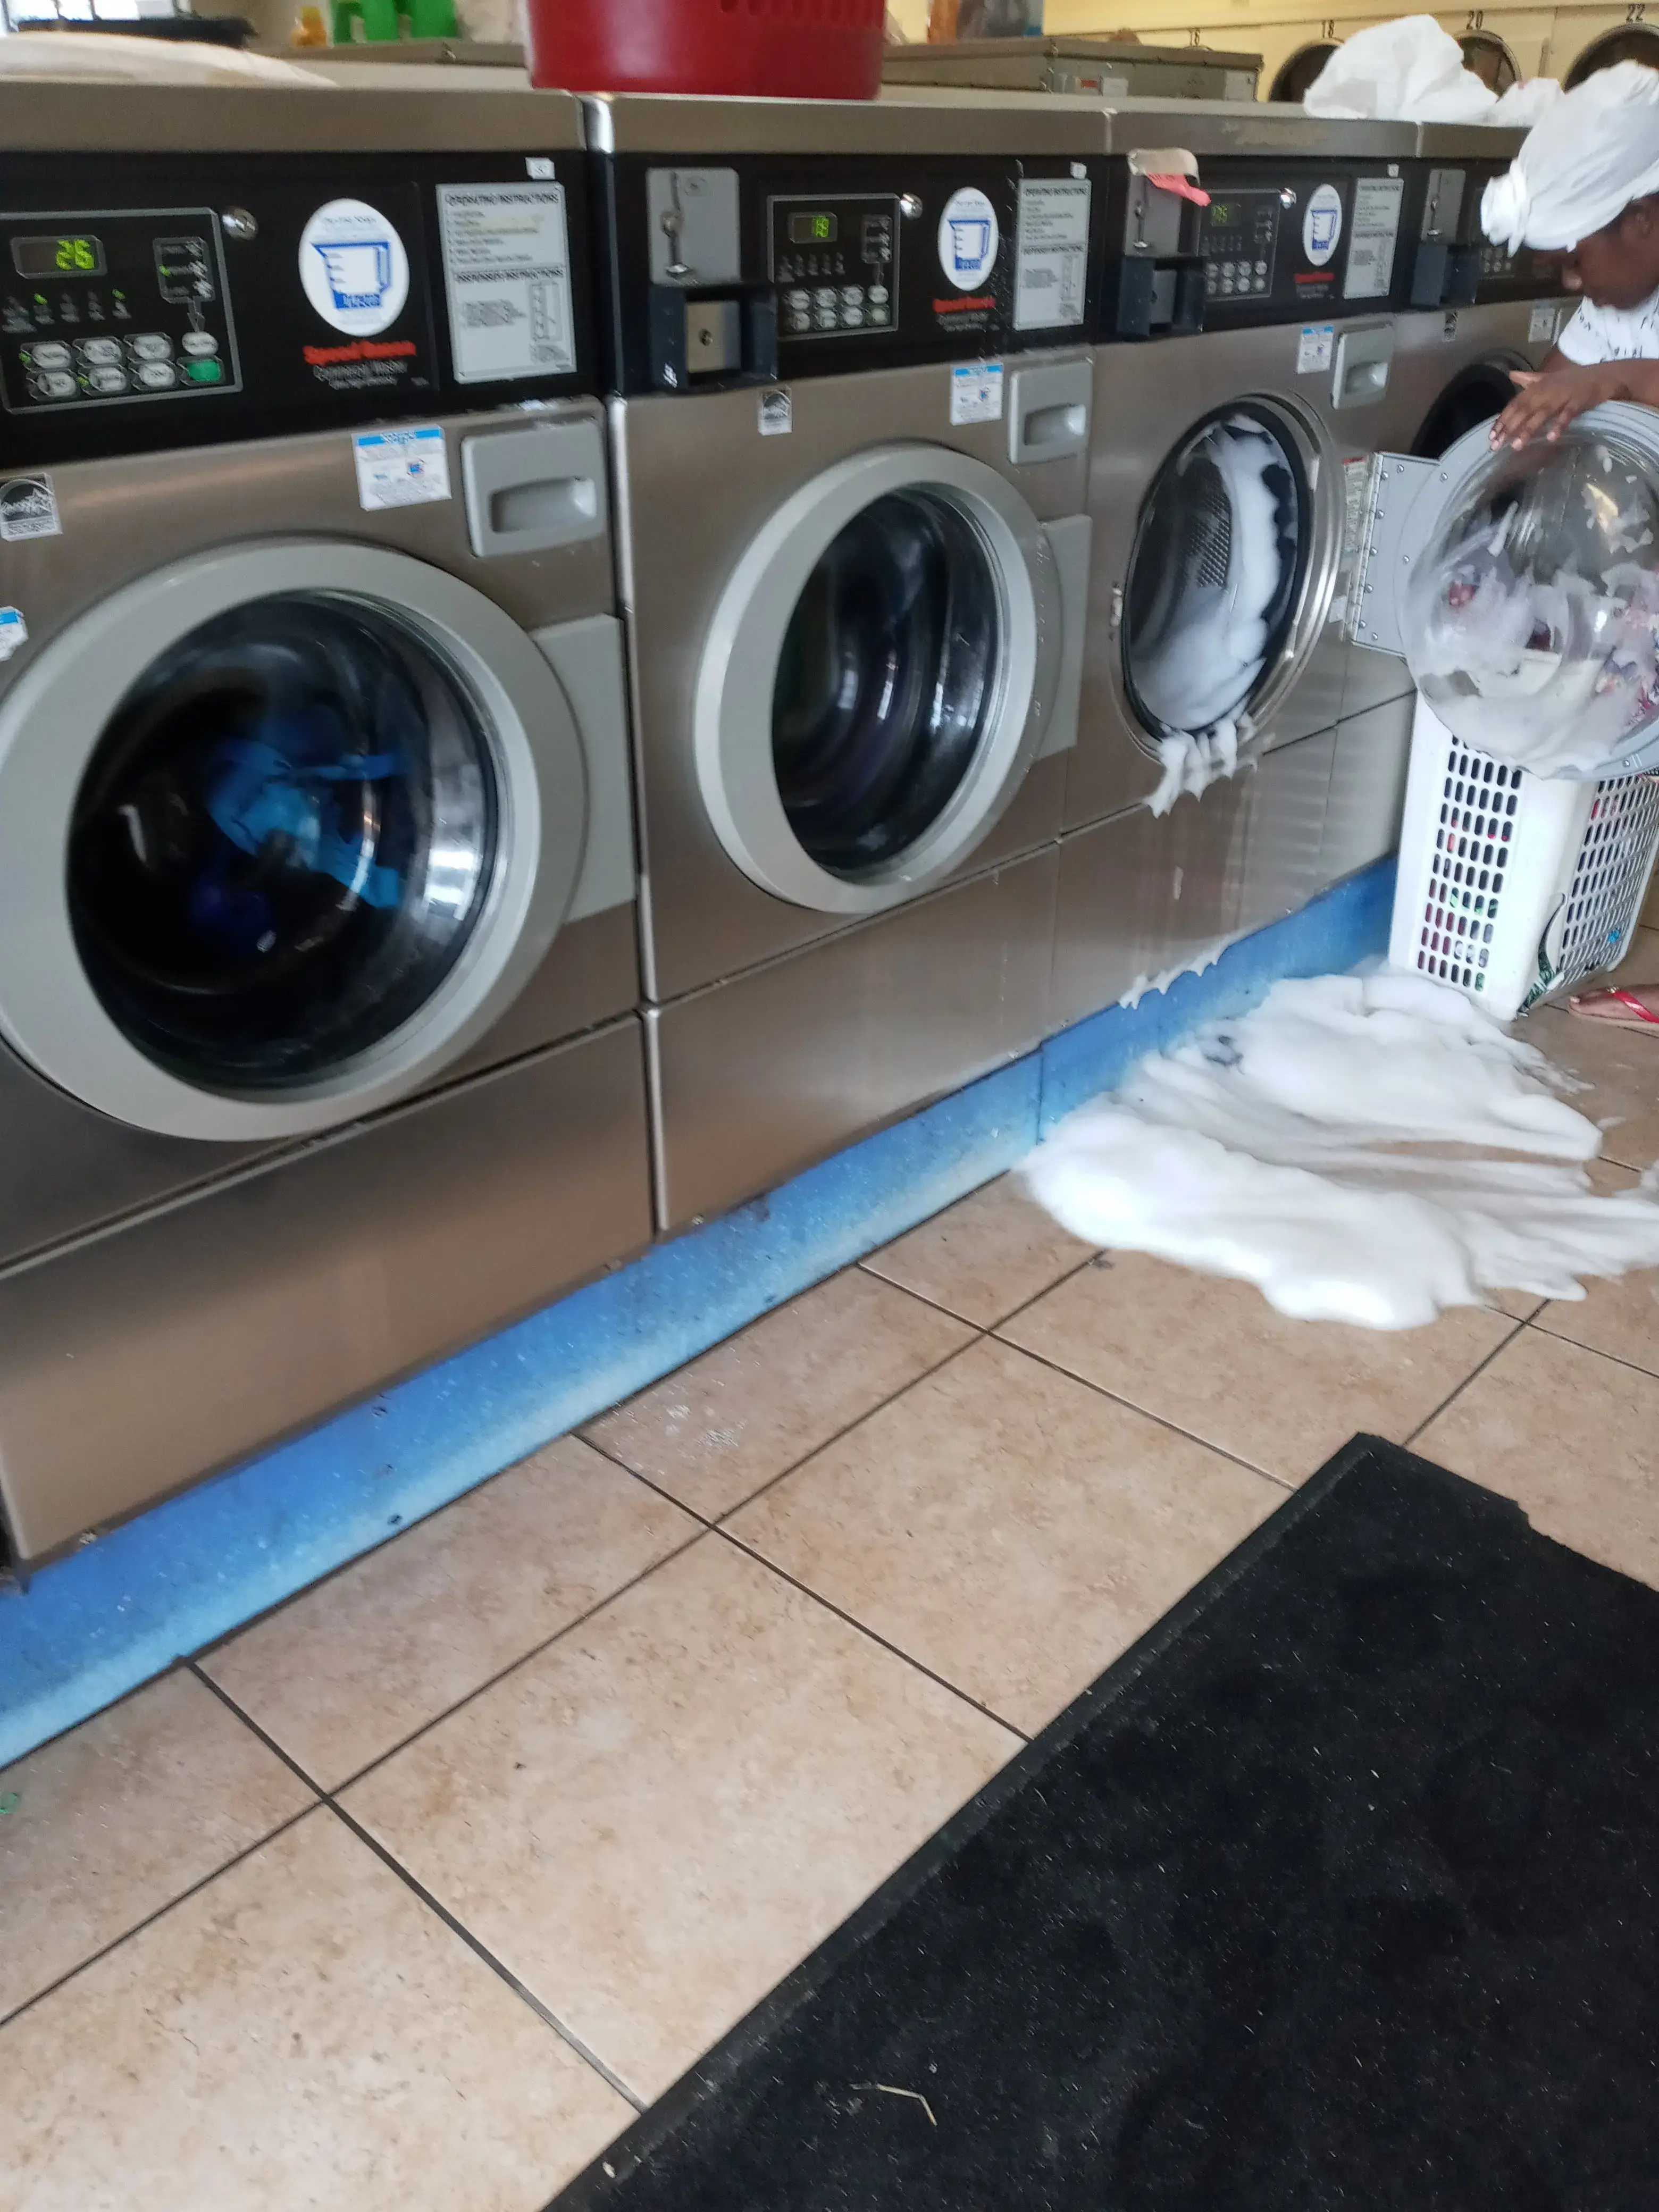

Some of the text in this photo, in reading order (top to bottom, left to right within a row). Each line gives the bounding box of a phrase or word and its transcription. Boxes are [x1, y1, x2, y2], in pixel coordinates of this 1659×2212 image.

[1466, 10, 1484, 30] 20
[1626, 4, 1645, 22] 22
[1321, 19, 1335, 38] 18
[55, 239, 95, 270] 26
